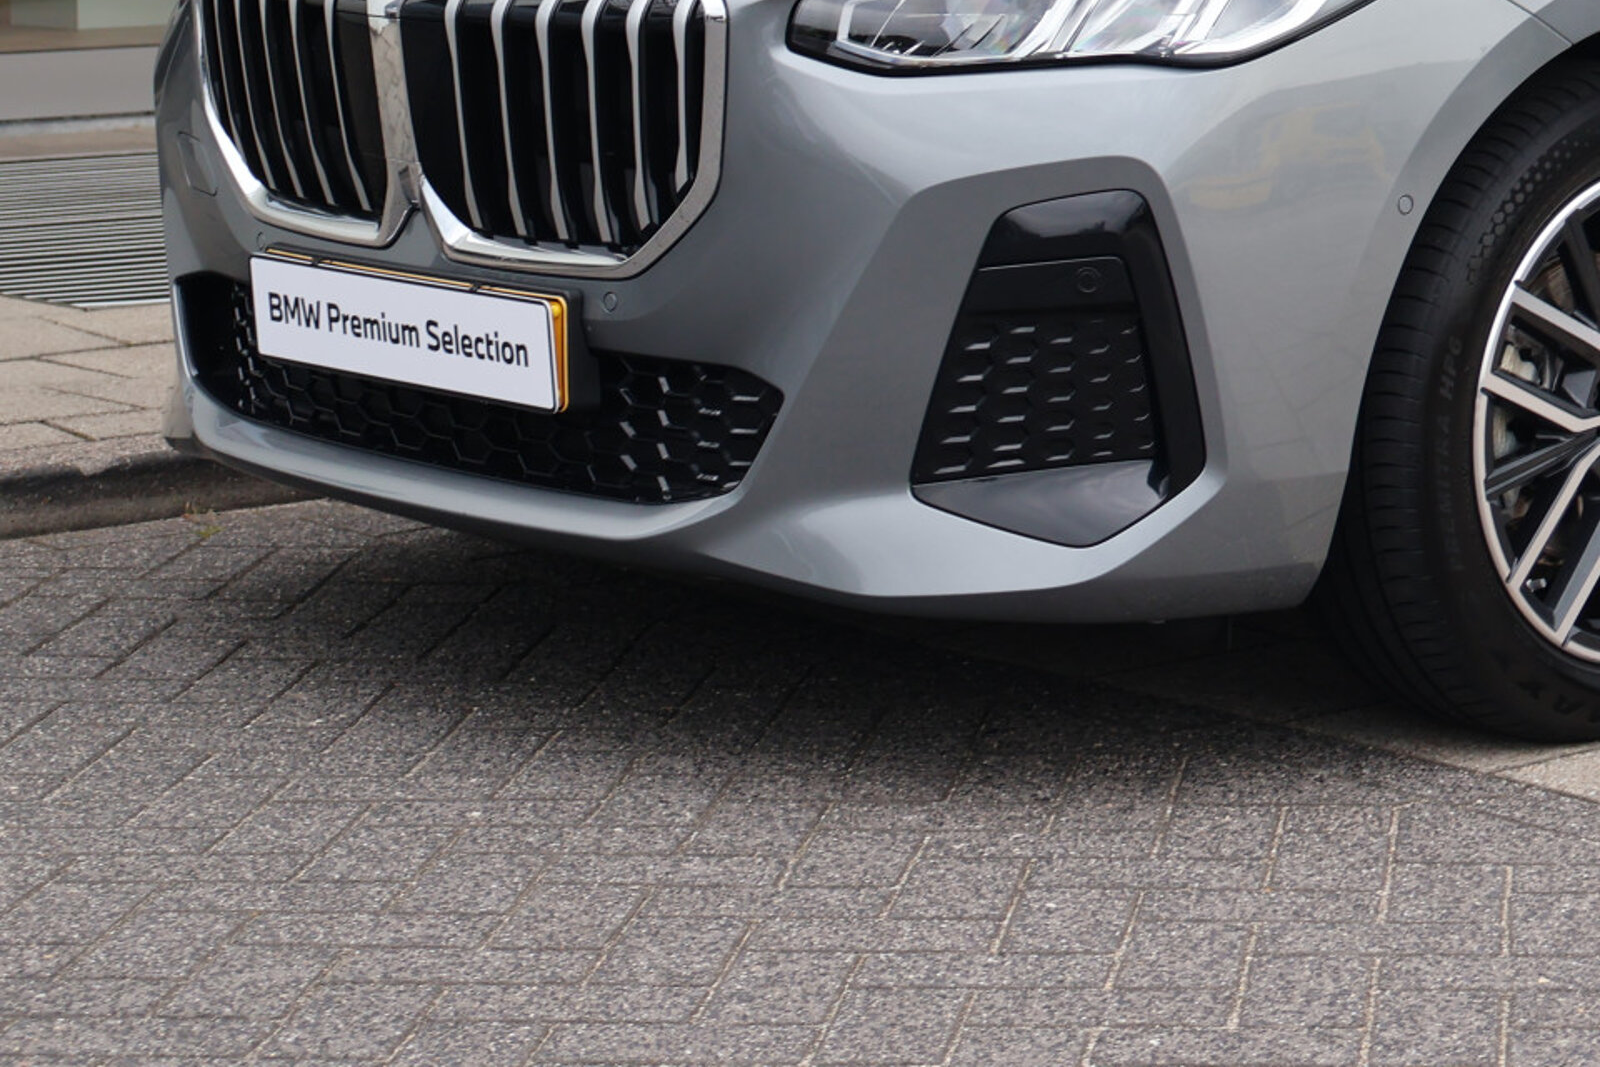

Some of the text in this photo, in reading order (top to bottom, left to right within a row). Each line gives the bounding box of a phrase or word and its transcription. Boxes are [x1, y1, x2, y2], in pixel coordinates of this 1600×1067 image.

[267, 291, 530, 368] BMW Premium Selection
